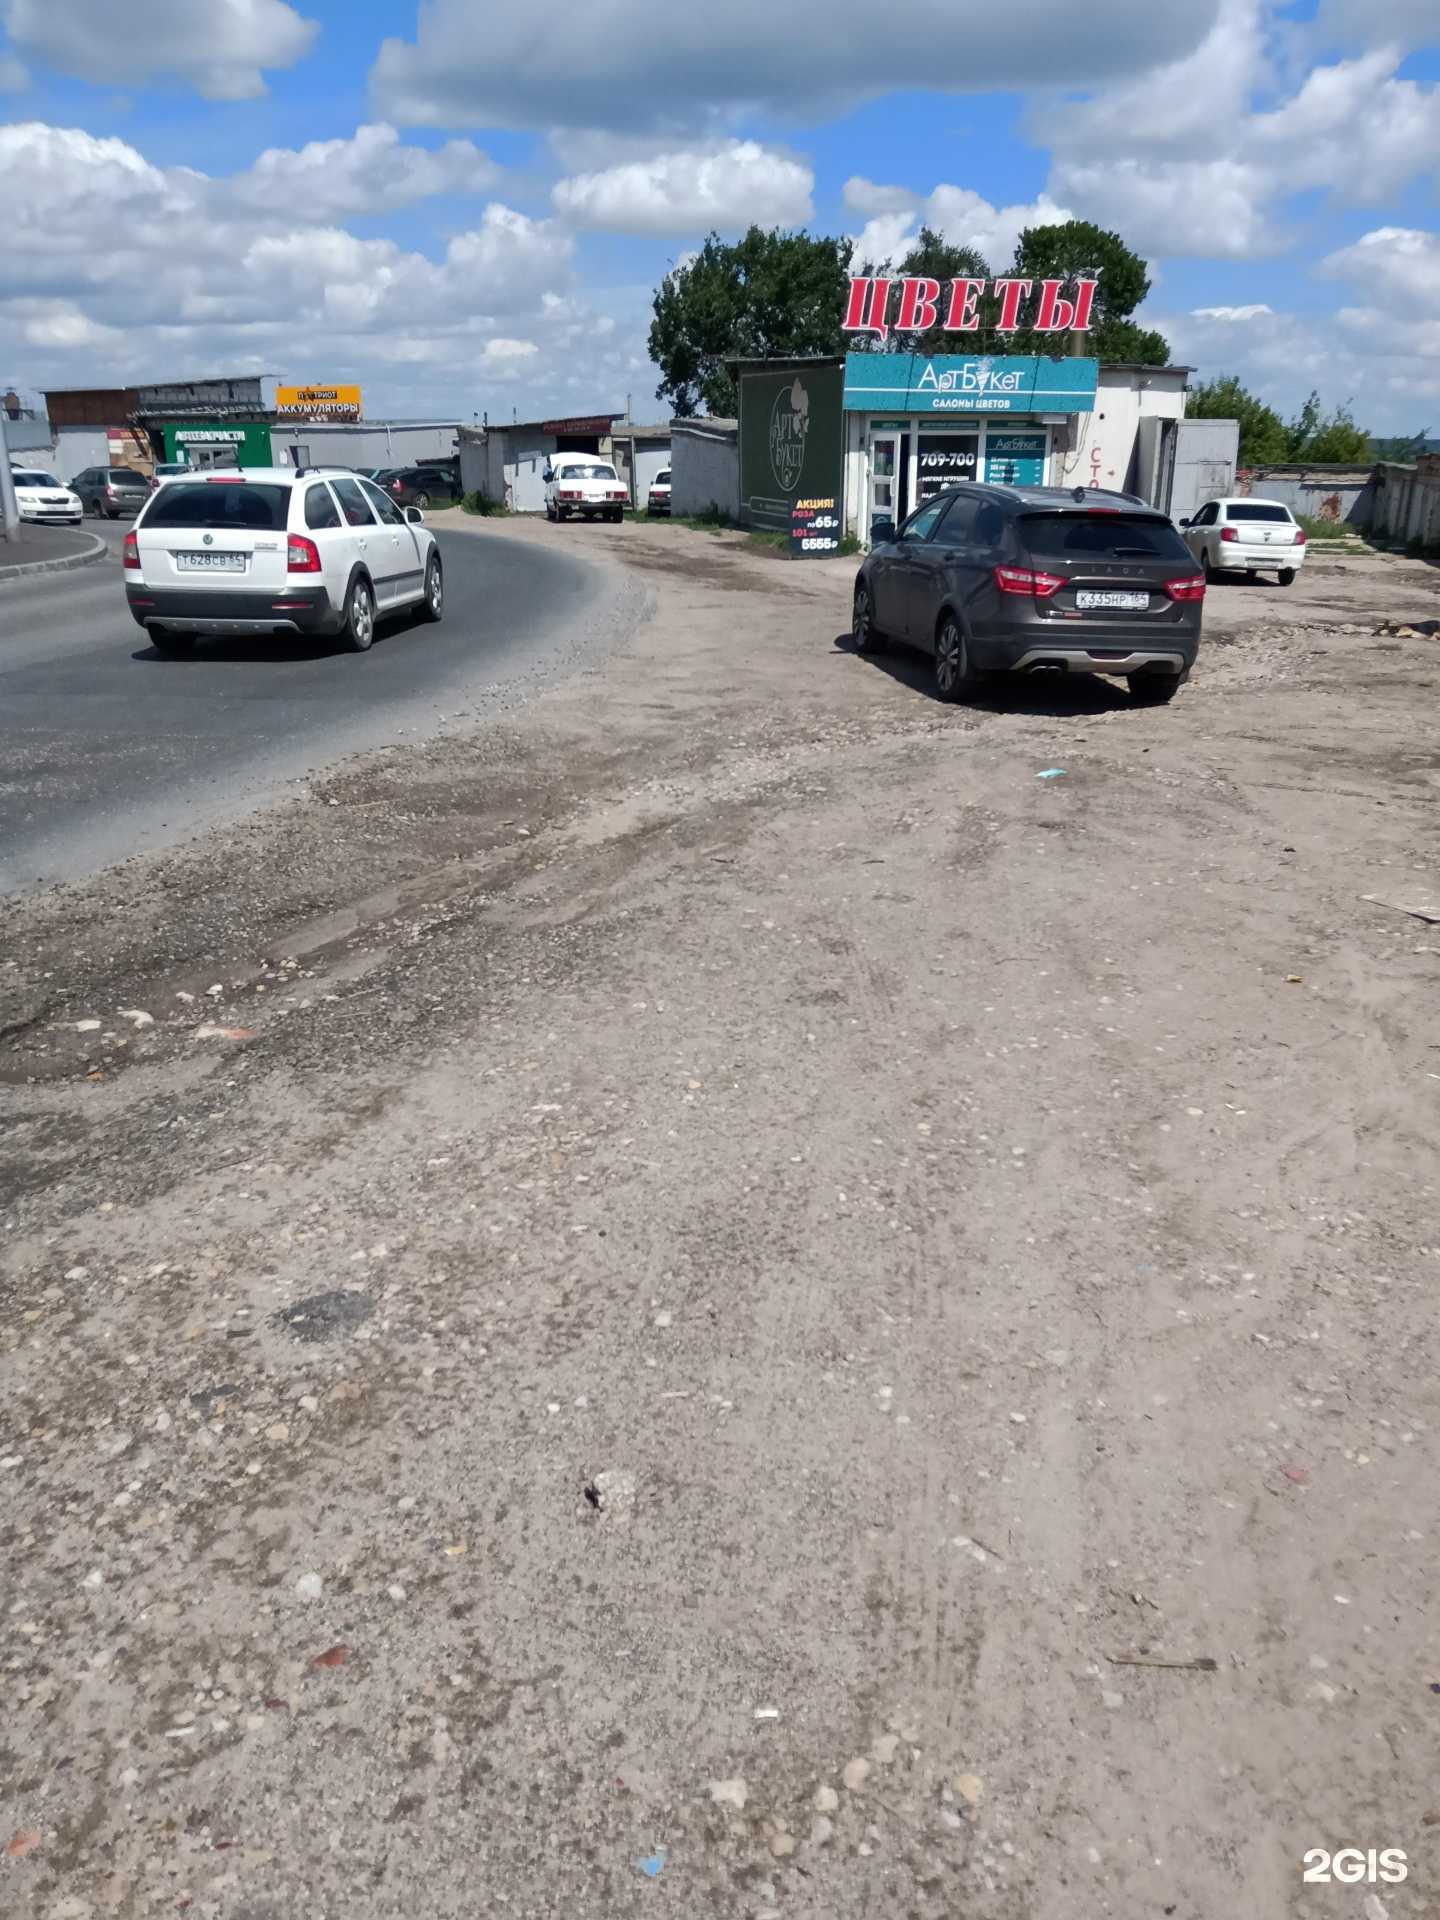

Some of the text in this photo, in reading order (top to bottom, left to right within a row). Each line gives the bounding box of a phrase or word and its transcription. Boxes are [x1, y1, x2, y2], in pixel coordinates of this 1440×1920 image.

[841, 277, 1099, 341] ЦВЕТЫ
[277, 403, 359, 414] АККУМУЛЯТОРЫ
[932, 398, 1010, 410] САЛОНЫ ЦВЕТОВ
[920, 452, 975, 467] 709-700
[796, 498, 834, 510] АКЦИЯ!
